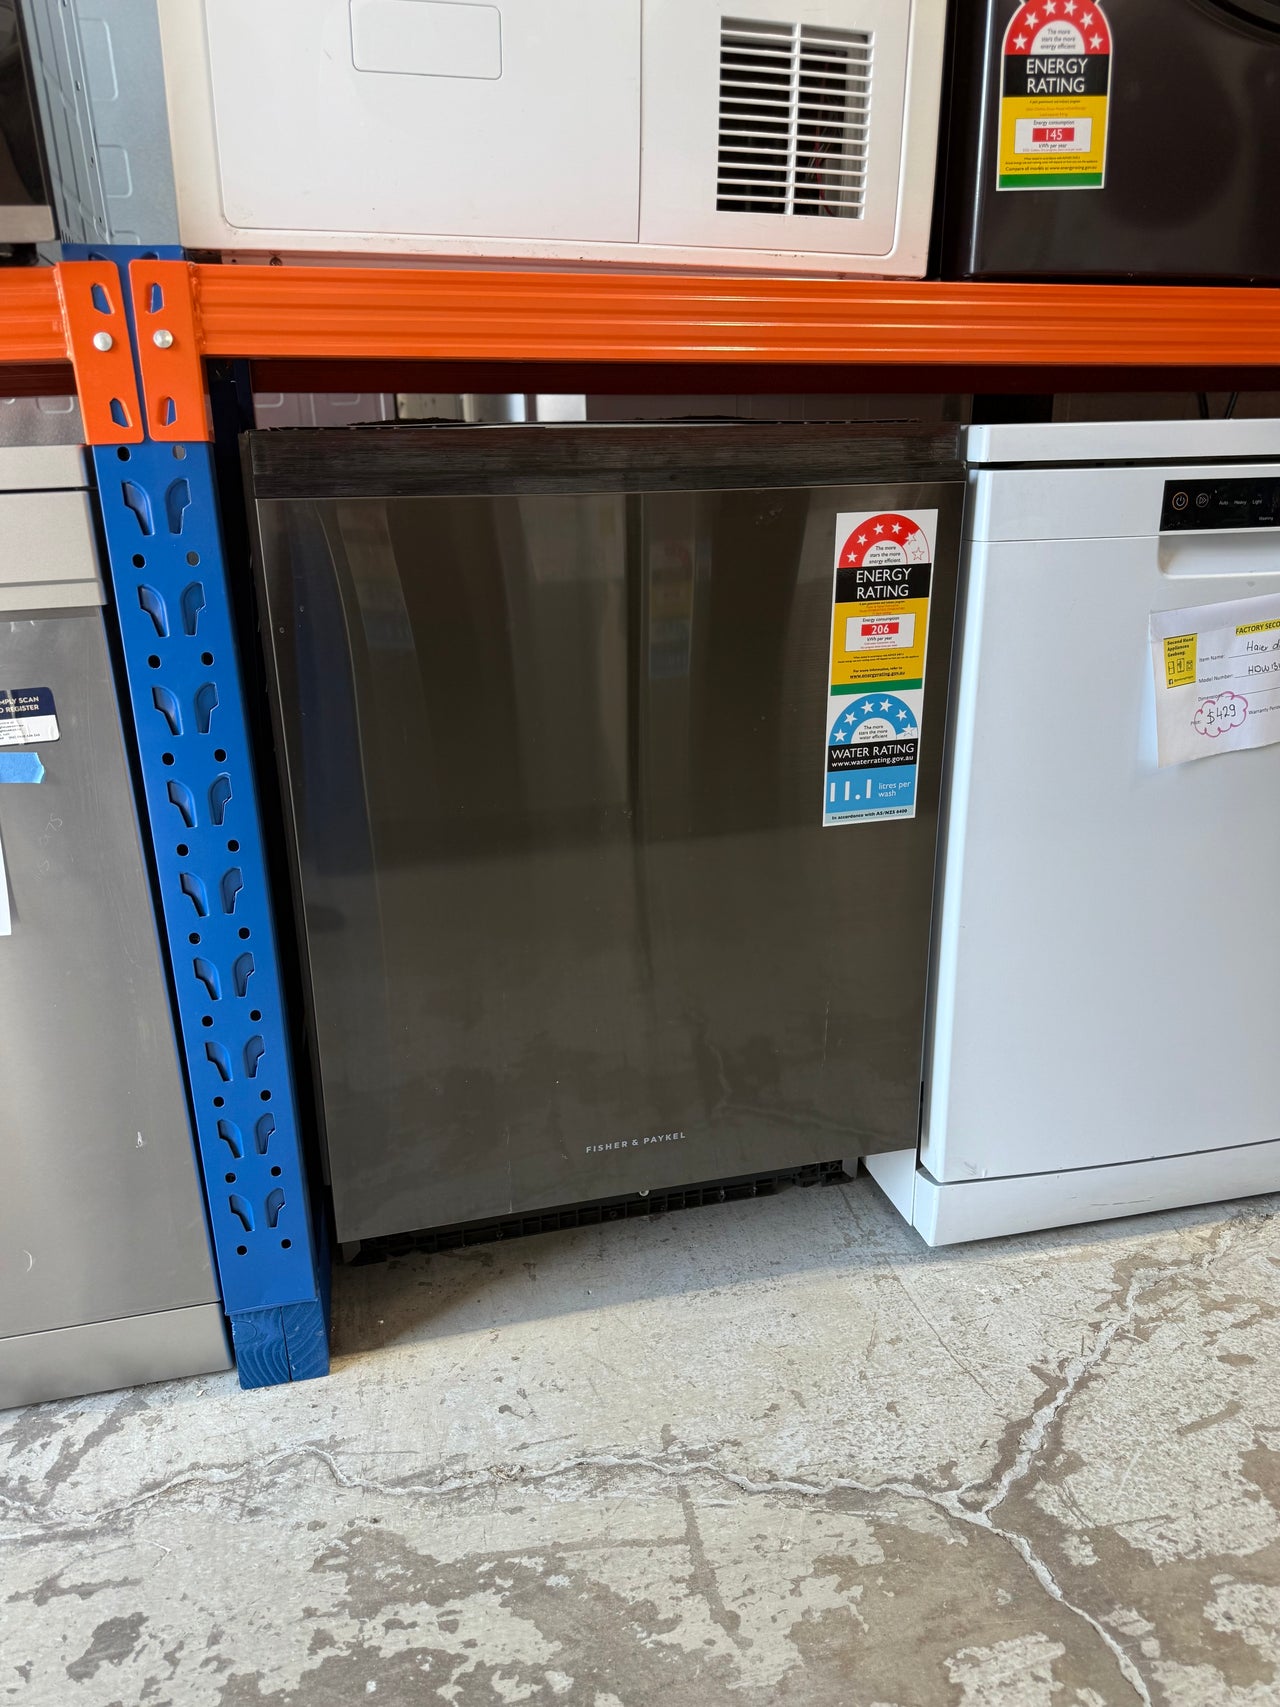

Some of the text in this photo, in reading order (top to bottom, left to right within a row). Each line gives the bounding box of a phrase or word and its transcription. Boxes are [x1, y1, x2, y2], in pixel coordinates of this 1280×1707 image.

[1026, 58, 1088, 74] ENERGY
[1027, 78, 1085, 94] RATING
[1045, 129, 1062, 141] 145
[856, 568, 912, 583] ENERGY
[856, 584, 909, 599] RATING
[871, 624, 889, 635] 206
[1236, 624, 1264, 635] FACTORY
[1246, 640, 1268, 652] Haier
[6, 704, 39, 713] REGISTER
[1207, 704, 1236, 725] $429
[831, 743, 915, 759] WATER RATING
[832, 756, 914, 767] www.waterrating.gov.au
[830, 779, 872, 802] 11.1
[586, 1141, 628, 1153] FISHER
[643, 1132, 686, 1144] PAYKEL
